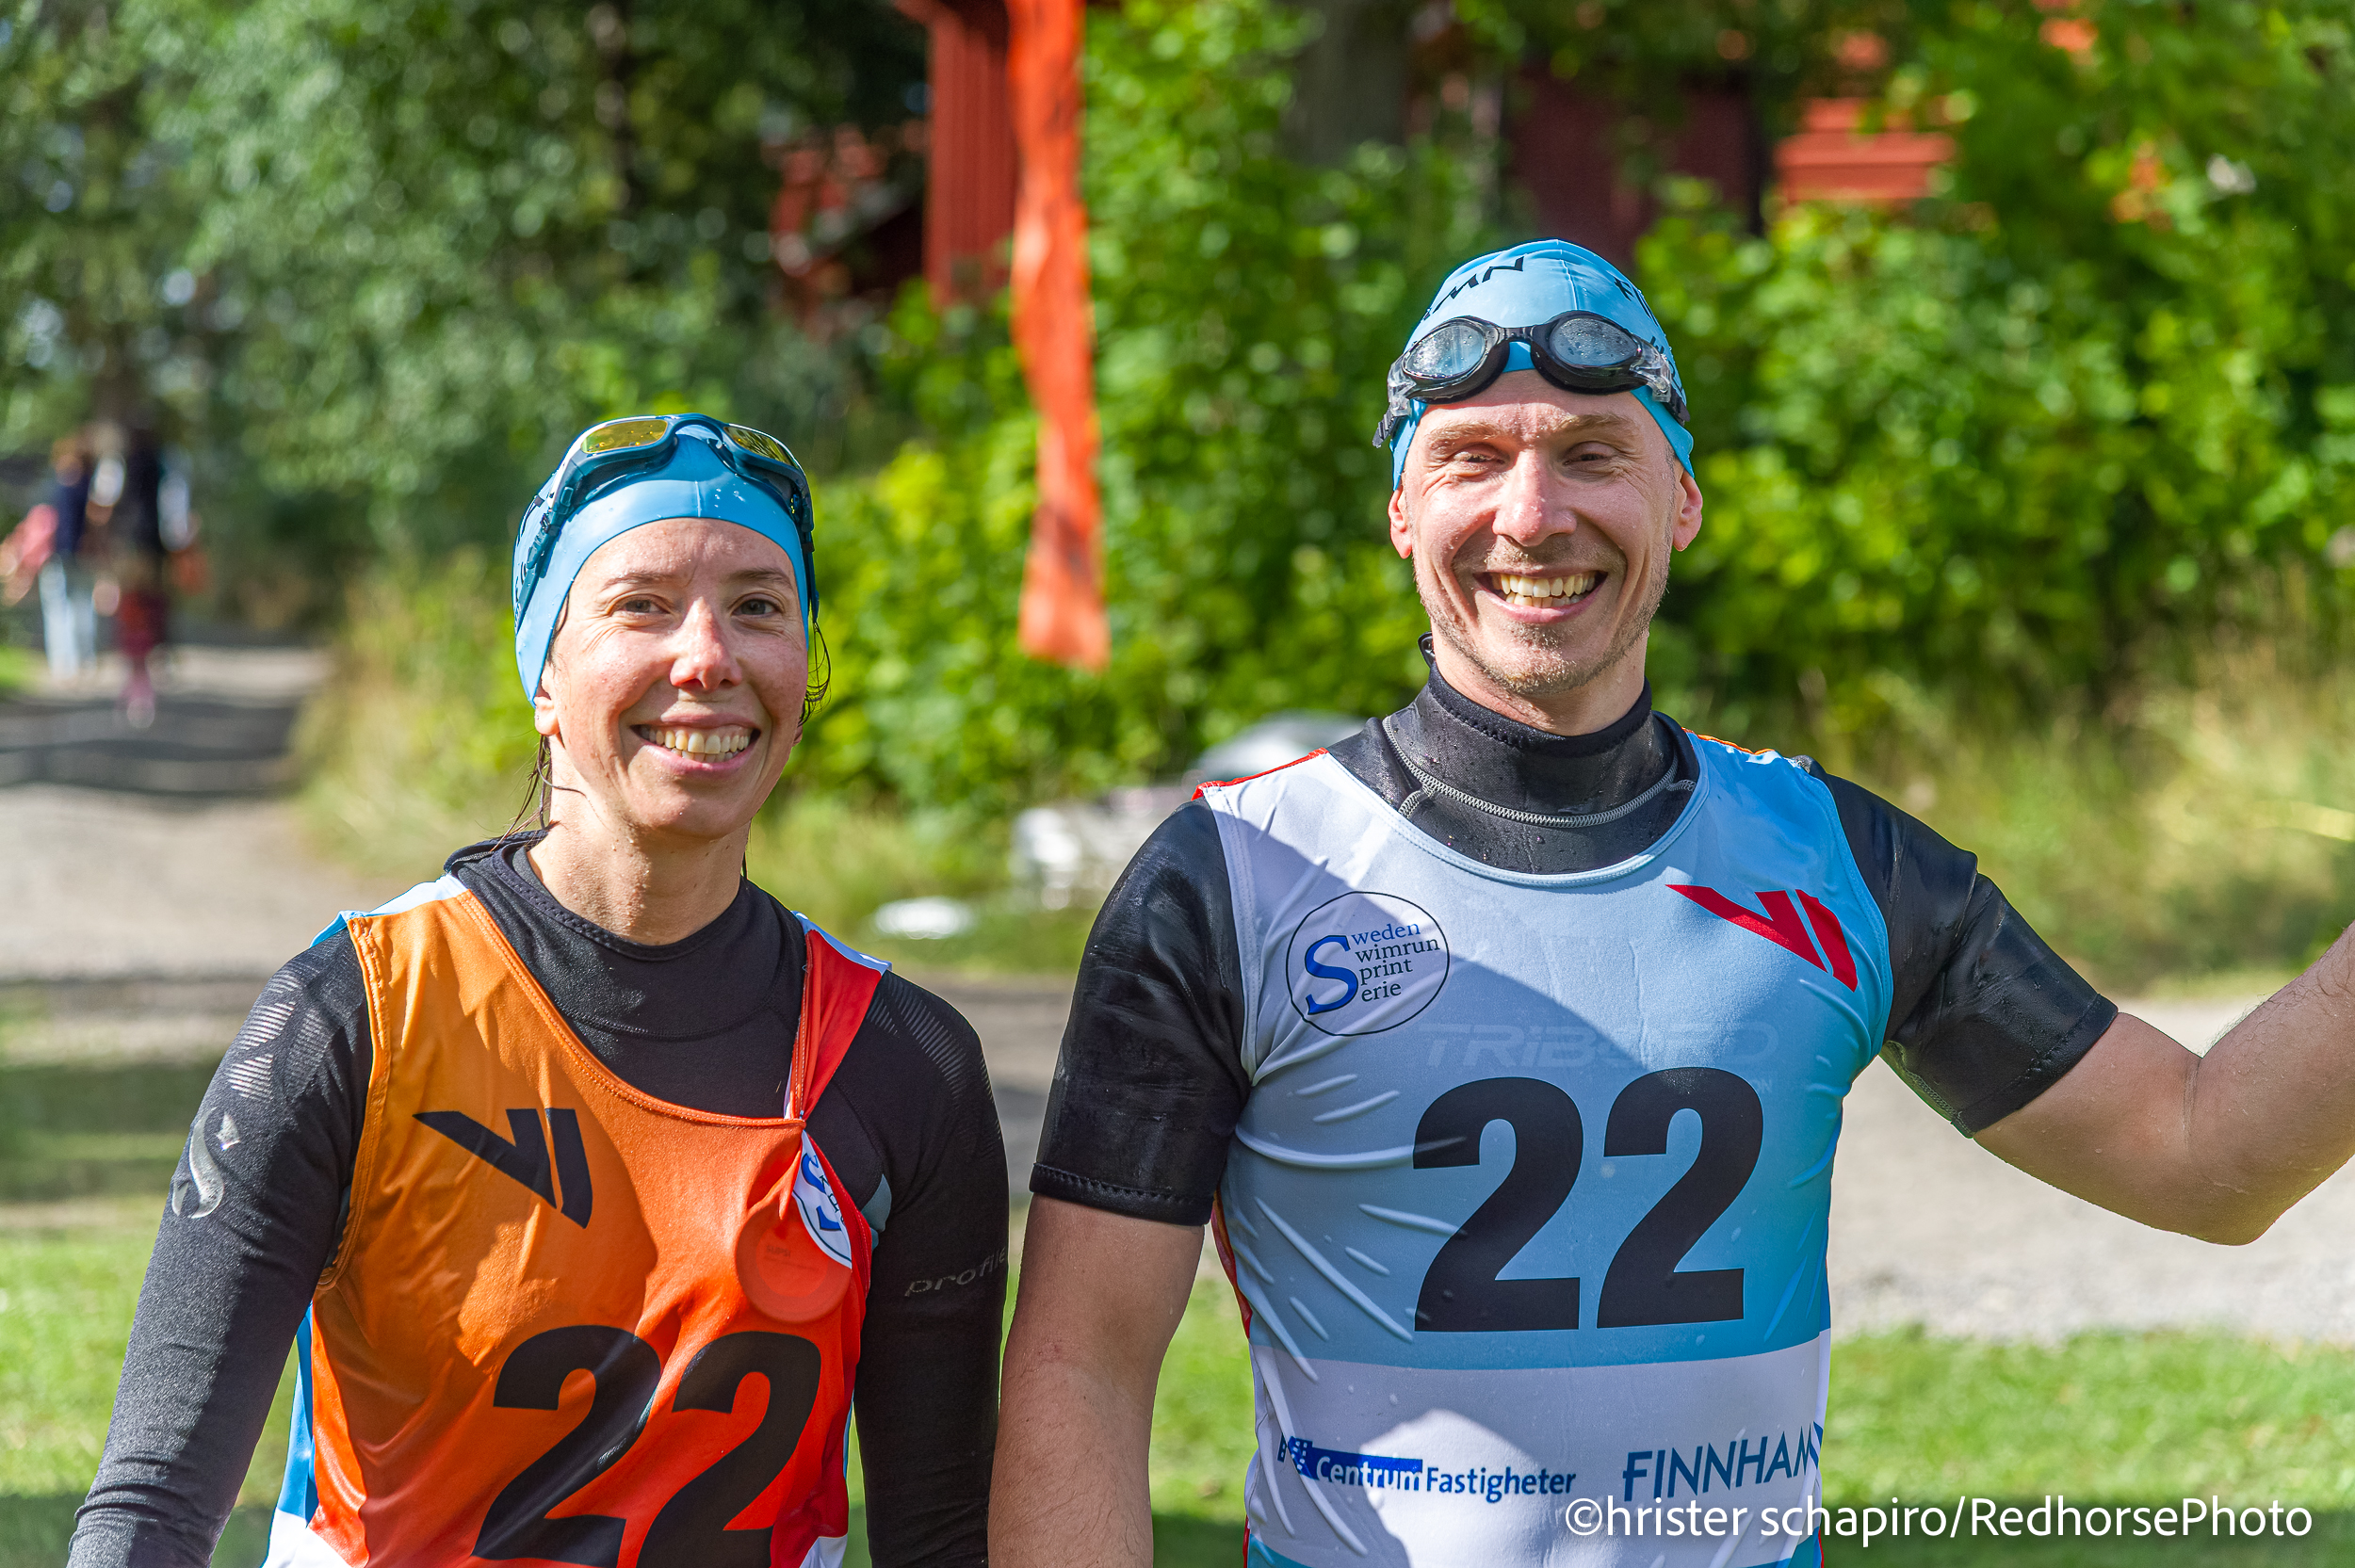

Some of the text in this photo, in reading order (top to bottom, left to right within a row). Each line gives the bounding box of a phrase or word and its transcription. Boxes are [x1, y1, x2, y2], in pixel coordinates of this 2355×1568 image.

[1413, 1066, 1764, 1332] 22
[471, 1324, 821, 1568] 22
[1316, 1455, 1577, 1504] Centrum Fastigheter
